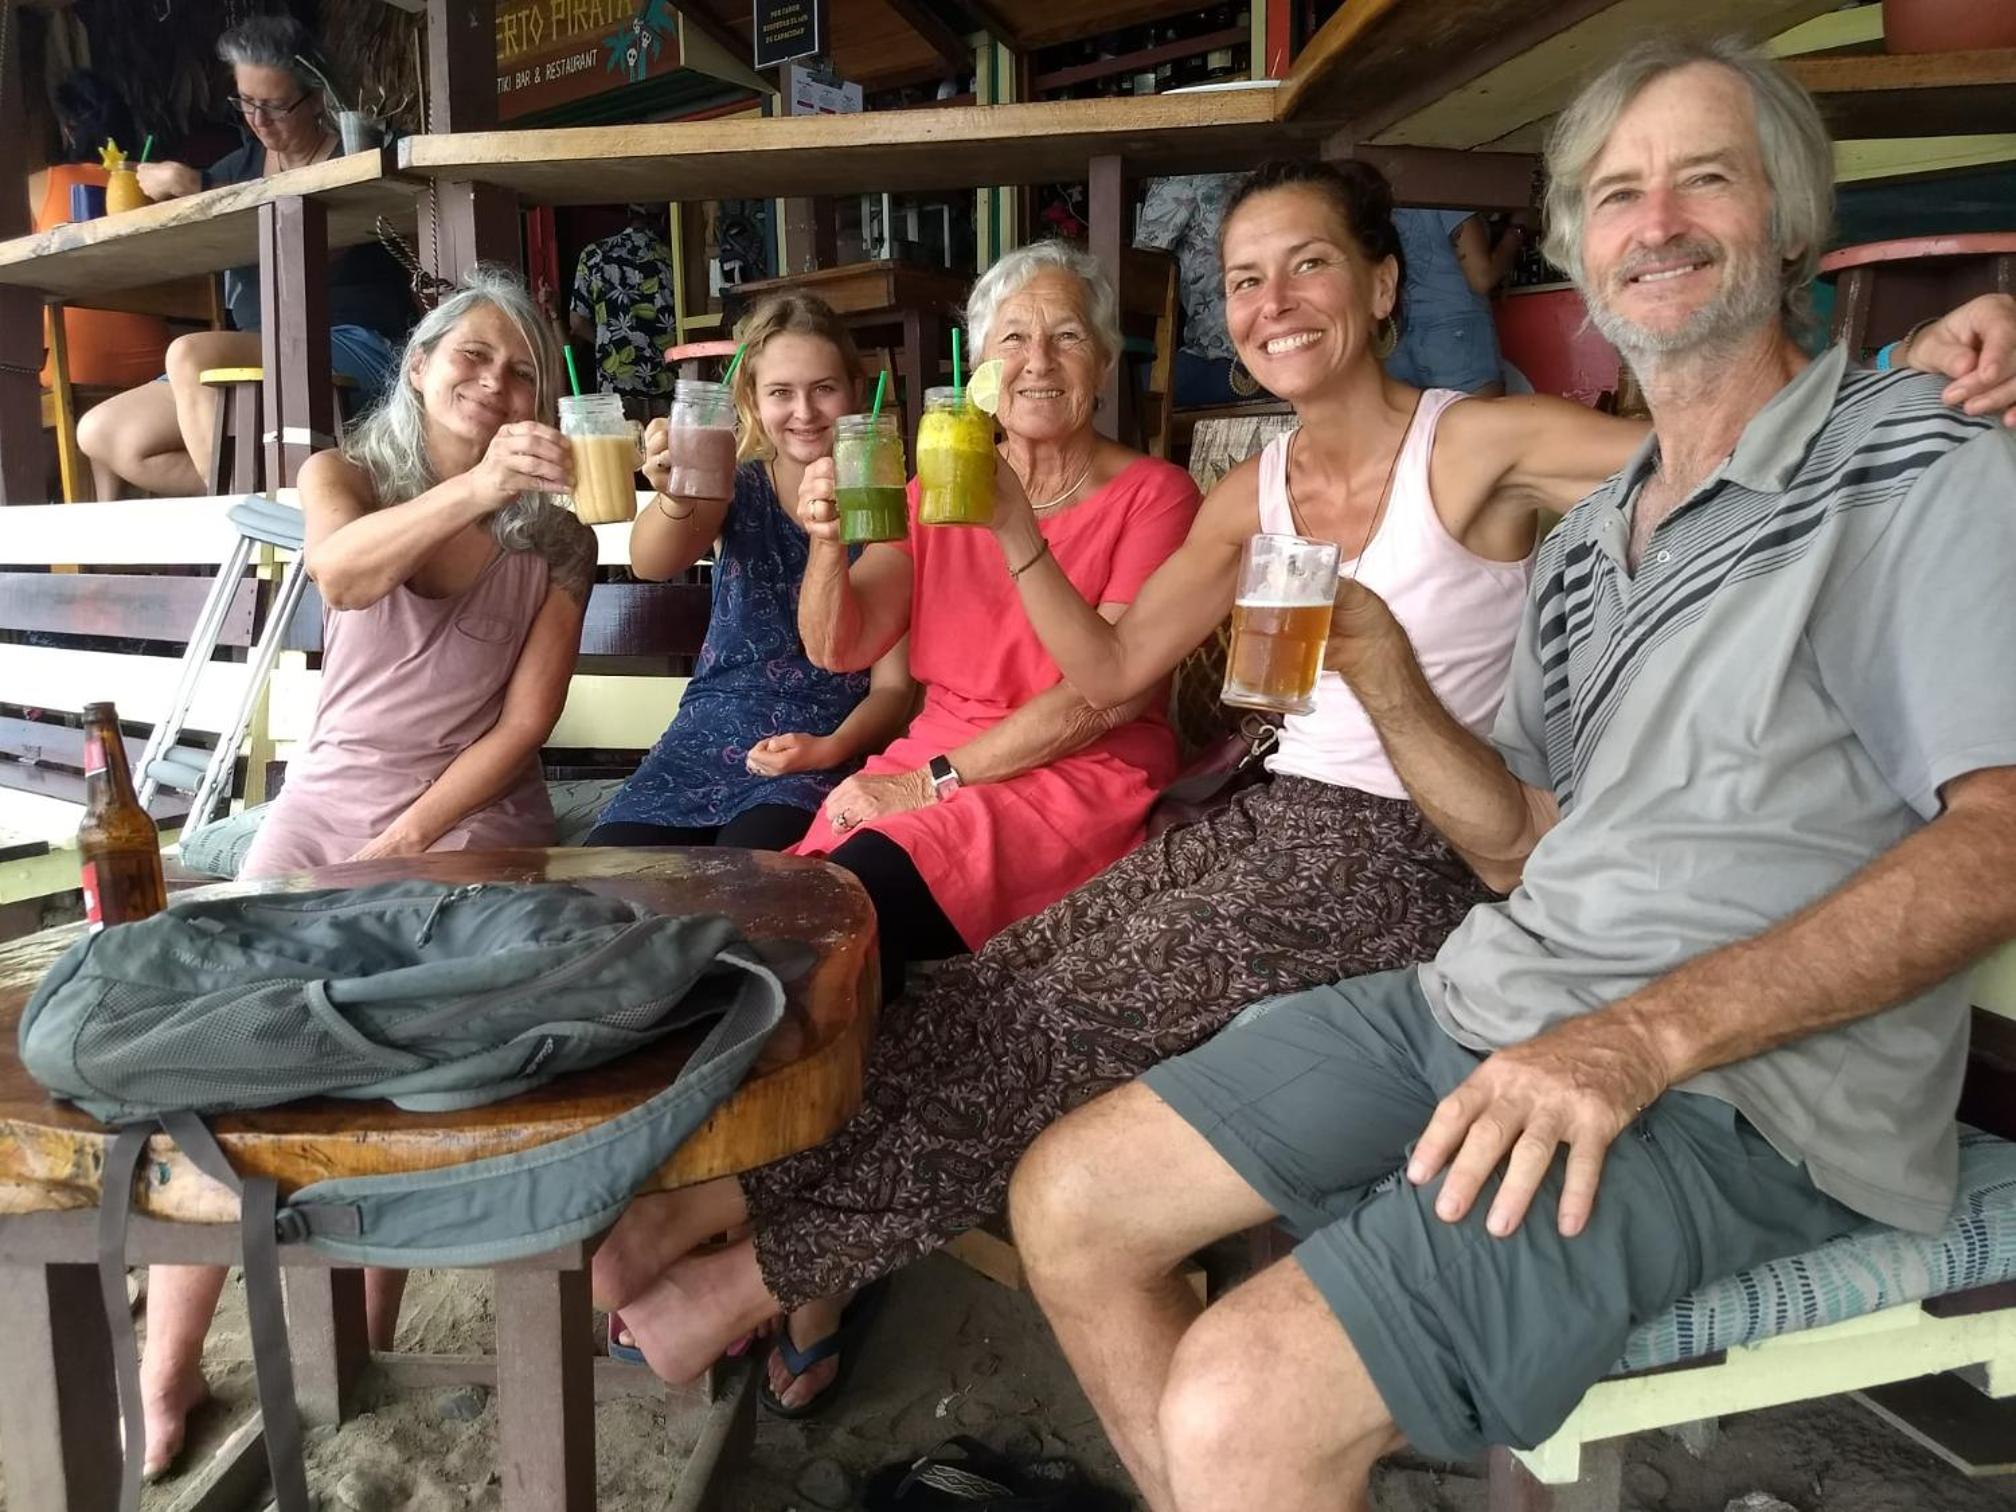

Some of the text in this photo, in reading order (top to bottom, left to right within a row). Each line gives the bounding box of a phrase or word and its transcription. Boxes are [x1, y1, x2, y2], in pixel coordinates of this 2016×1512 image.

[497, 49, 598, 93] TIKI BAR & RESTAURANT
